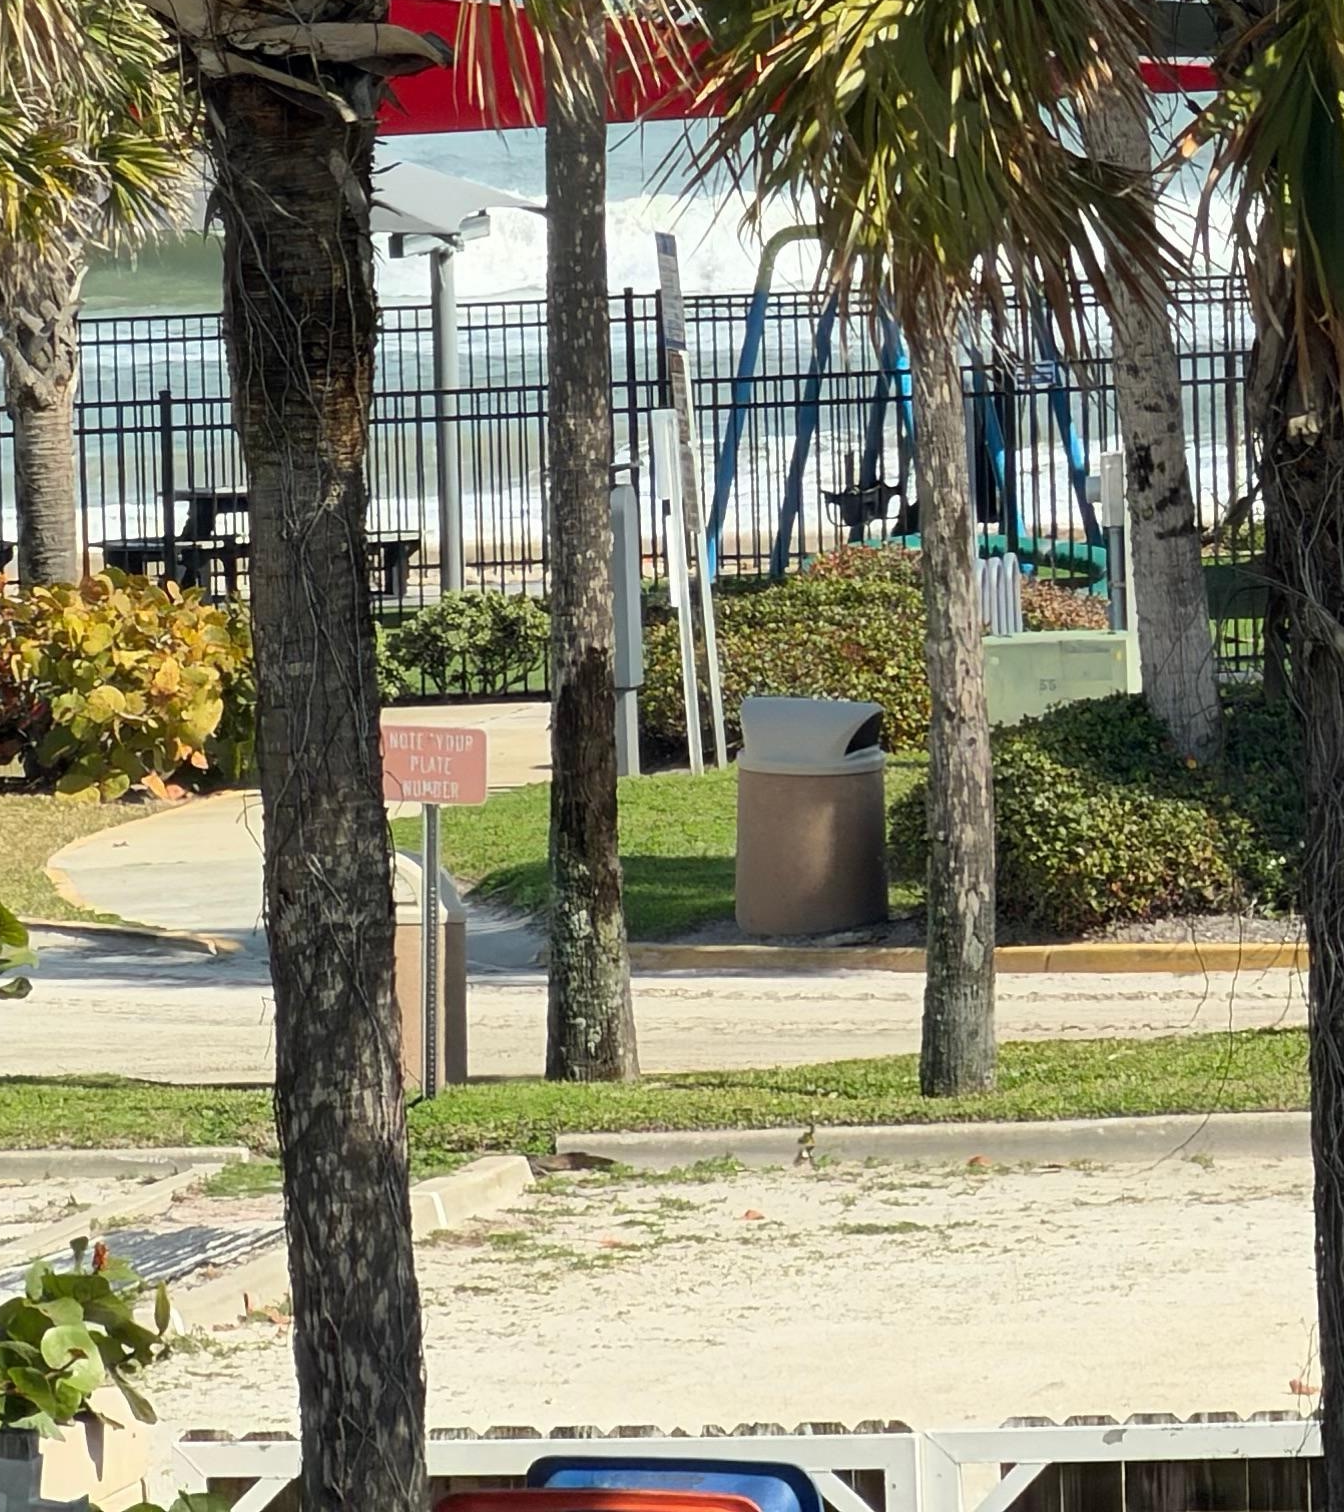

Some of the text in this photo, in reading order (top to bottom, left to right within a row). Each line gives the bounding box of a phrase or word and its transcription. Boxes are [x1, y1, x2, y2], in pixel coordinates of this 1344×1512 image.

[389, 732, 473, 752] NOTE YOUR
[410, 755, 452, 775] PLATE
[401, 779, 458, 799] NUMBER
